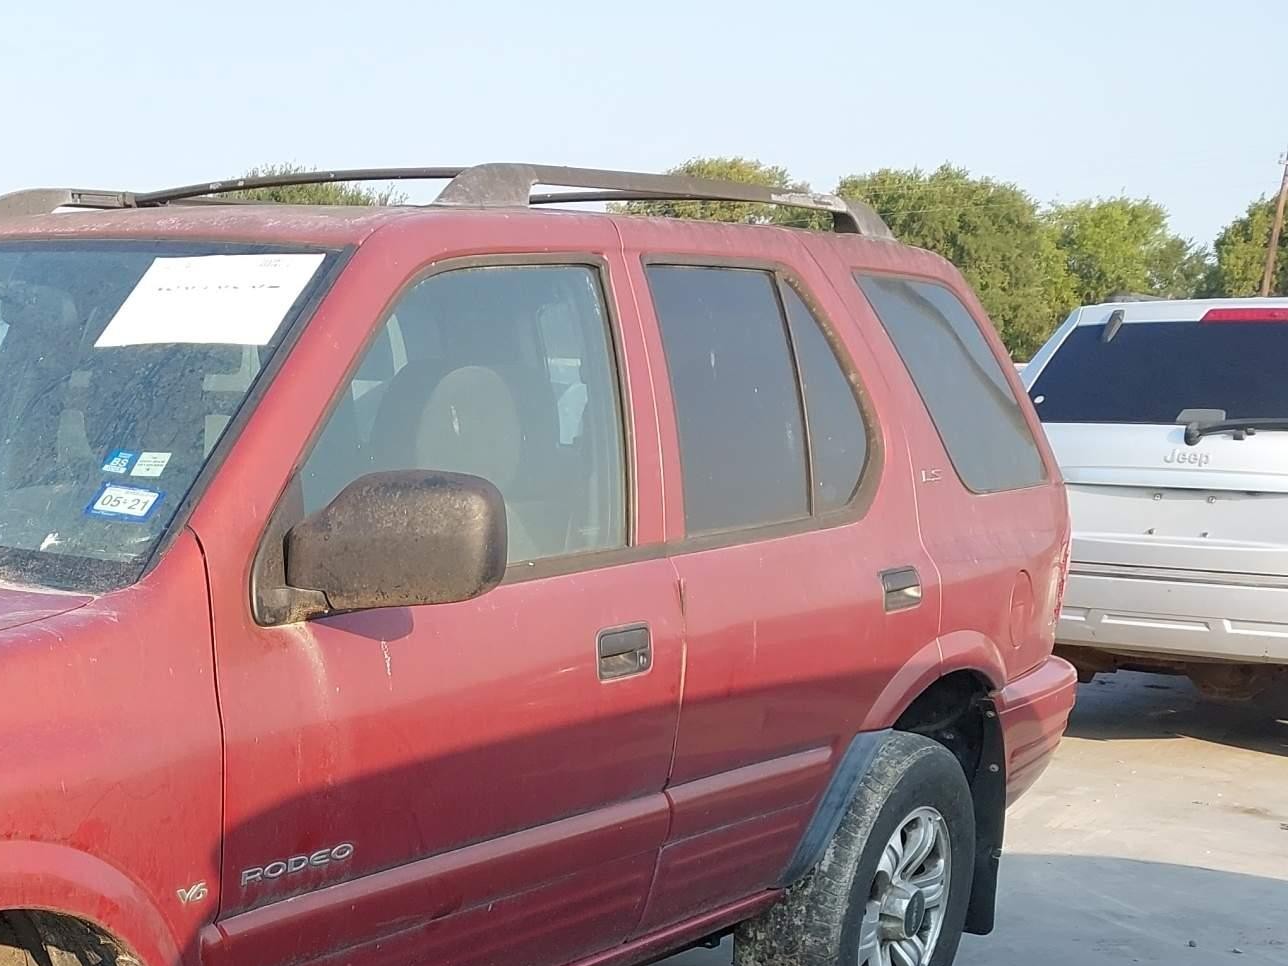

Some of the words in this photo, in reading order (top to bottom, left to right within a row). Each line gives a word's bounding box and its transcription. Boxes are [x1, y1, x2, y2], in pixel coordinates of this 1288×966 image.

[1163, 448, 1209, 468] Jeep
[240, 842, 355, 888] RODEO
[176, 880, 208, 904] V6
